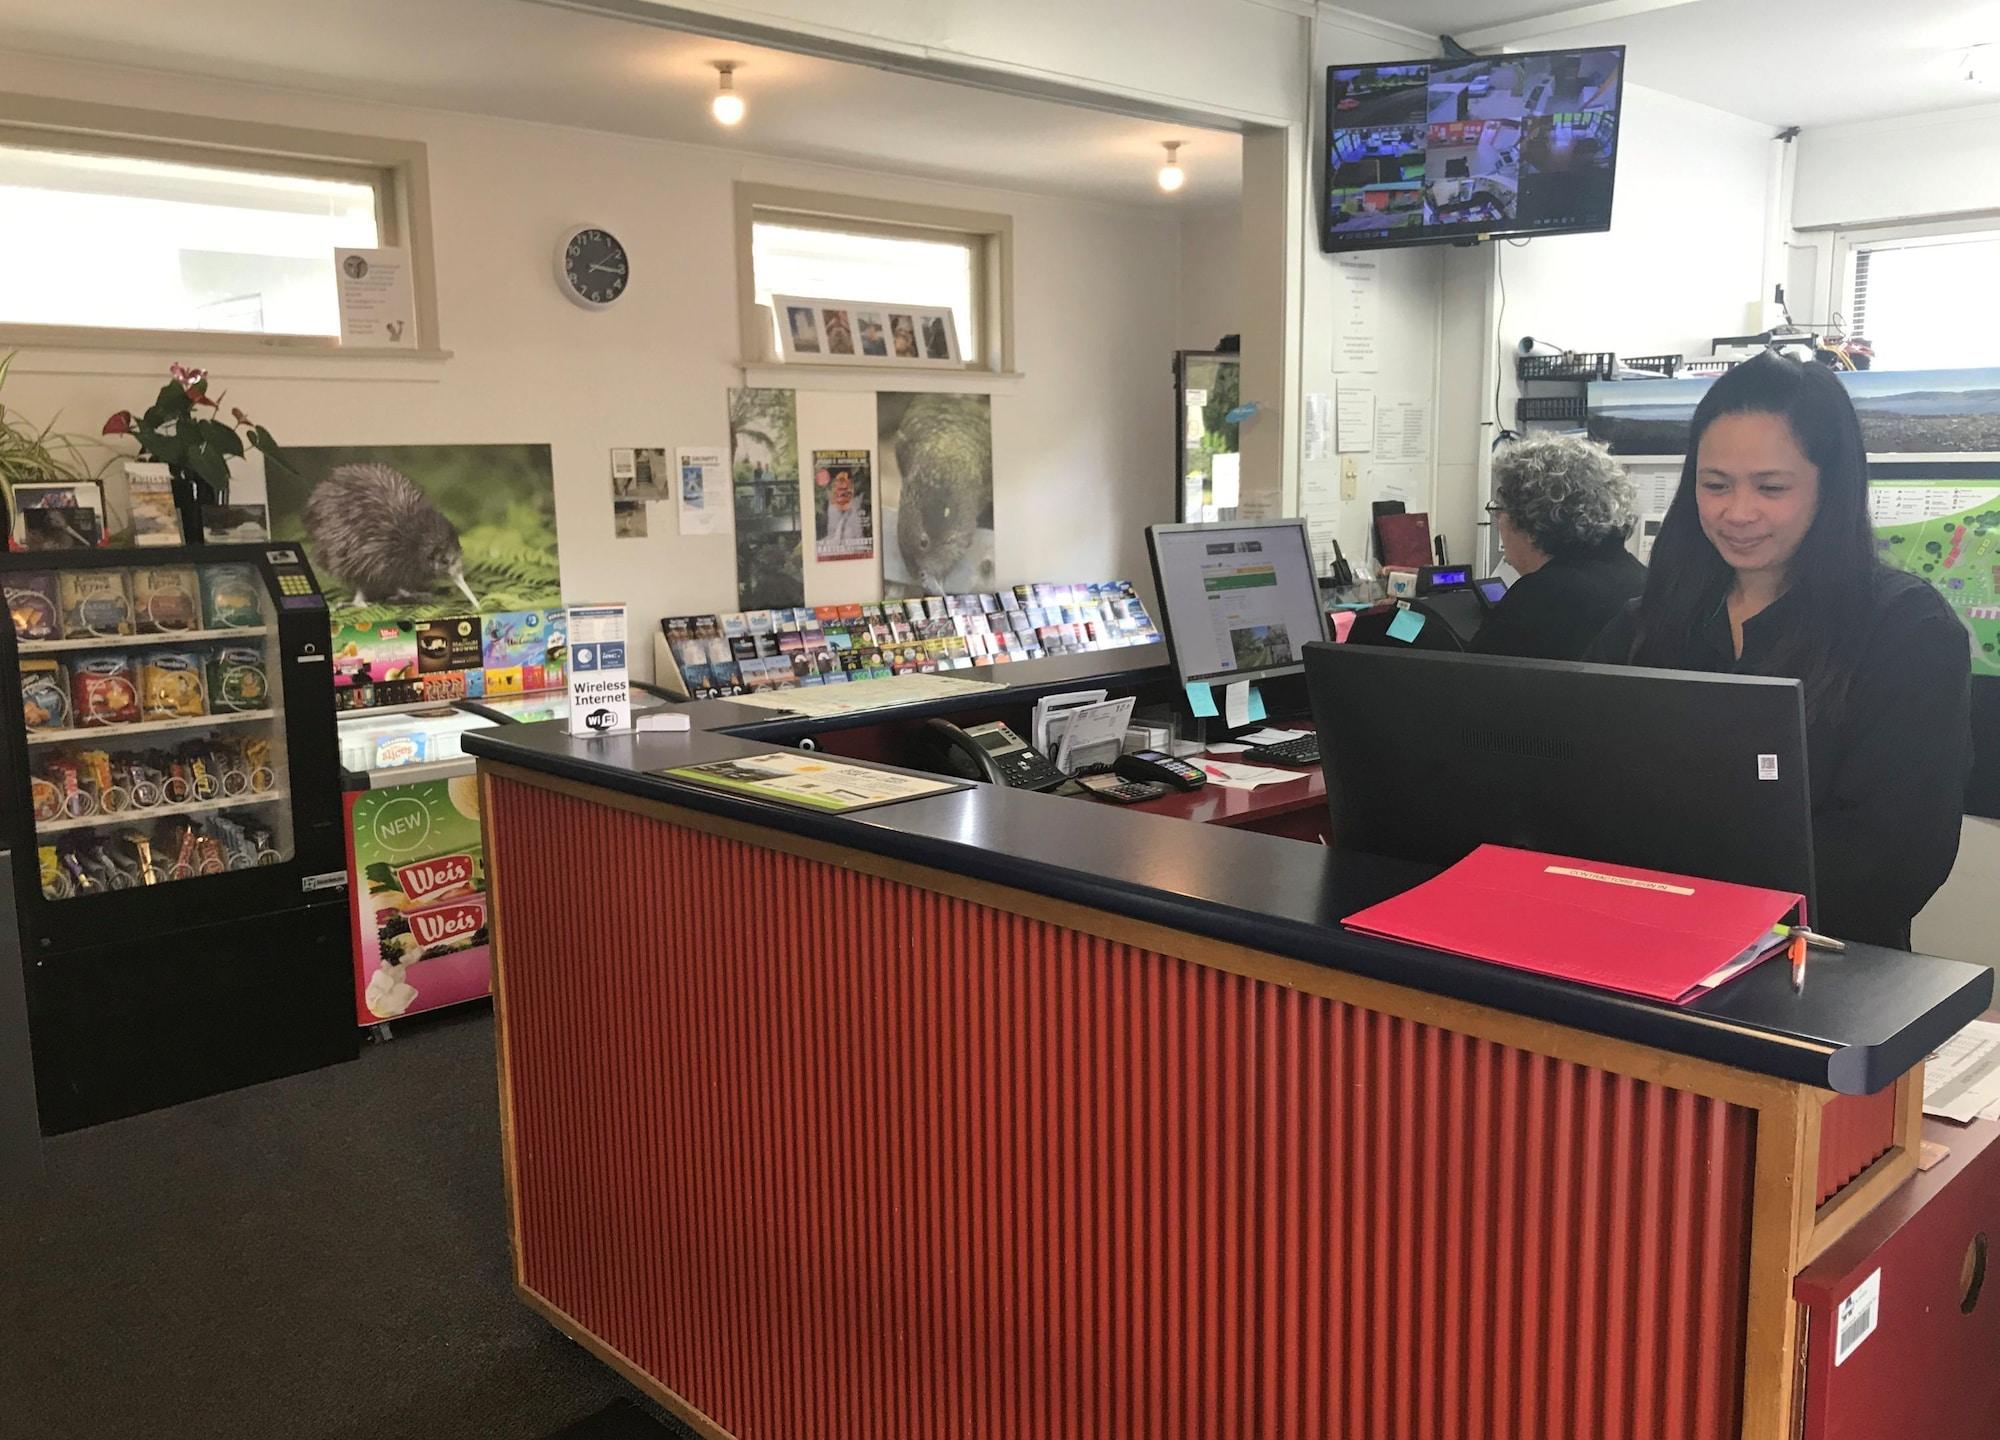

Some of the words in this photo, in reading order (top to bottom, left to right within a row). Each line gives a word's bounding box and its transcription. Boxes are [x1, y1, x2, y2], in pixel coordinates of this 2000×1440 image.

[574, 680, 627, 694] Wireless
[575, 692, 627, 706] Internet
[380, 811, 422, 840] NEW
[405, 861, 466, 895] Weis
[417, 910, 477, 943] Weis
